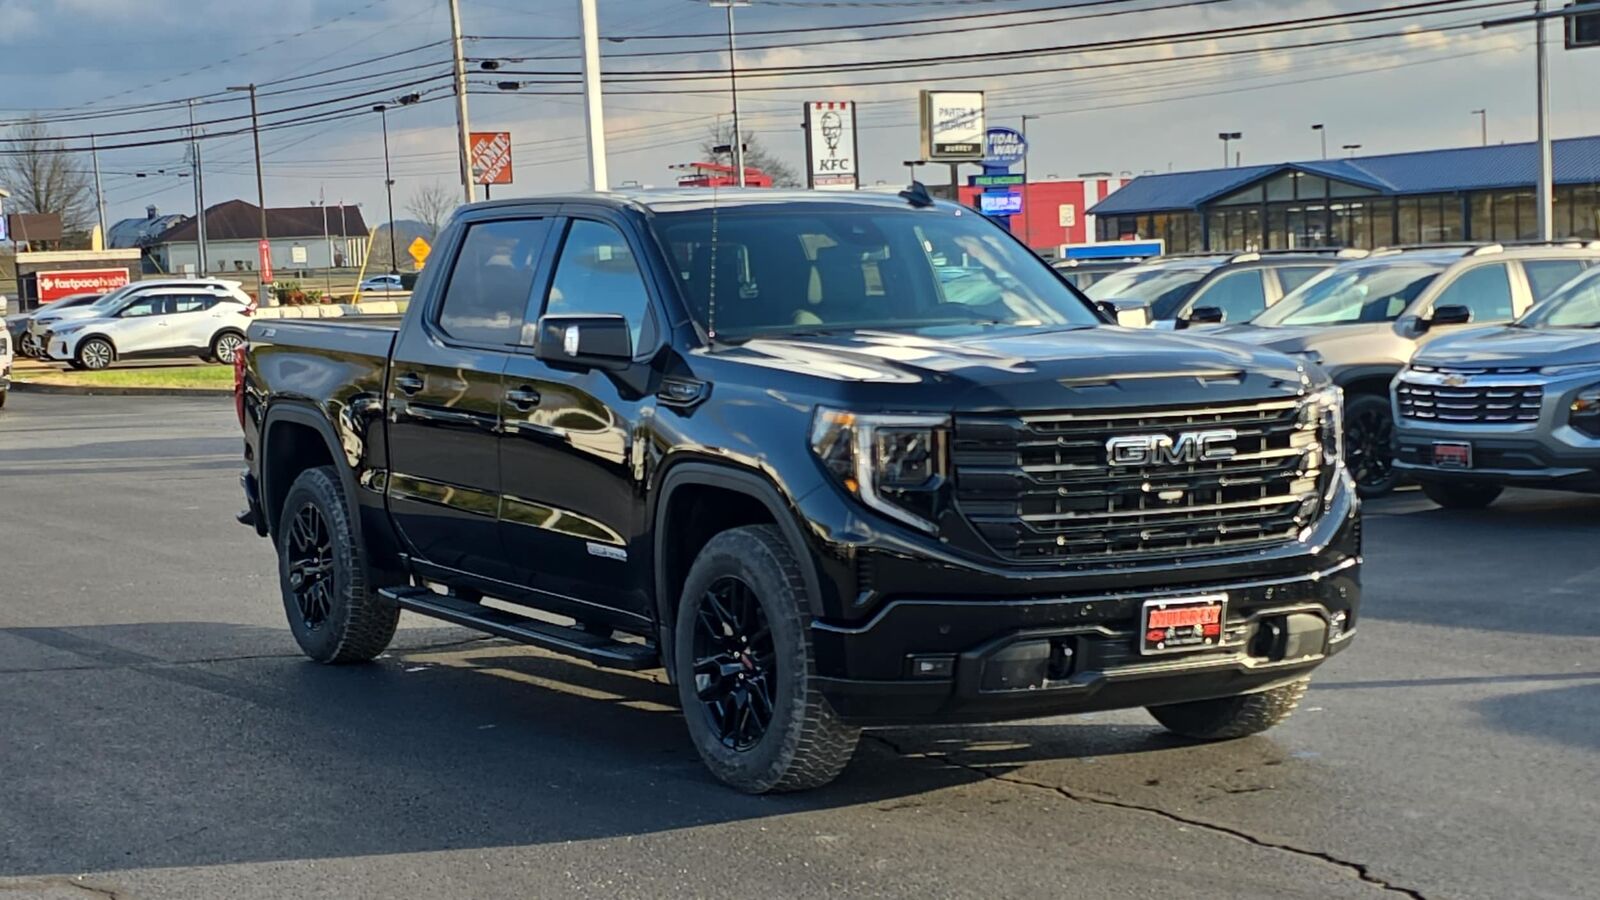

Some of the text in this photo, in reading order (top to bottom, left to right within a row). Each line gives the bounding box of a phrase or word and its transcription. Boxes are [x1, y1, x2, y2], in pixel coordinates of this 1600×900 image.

[989, 132, 1019, 145] TIDAL
[472, 138, 489, 159] THE
[993, 143, 1025, 155] WAVE
[485, 154, 511, 183] DEPOT
[820, 158, 849, 171] KFC
[1105, 429, 1238, 466] GMC
